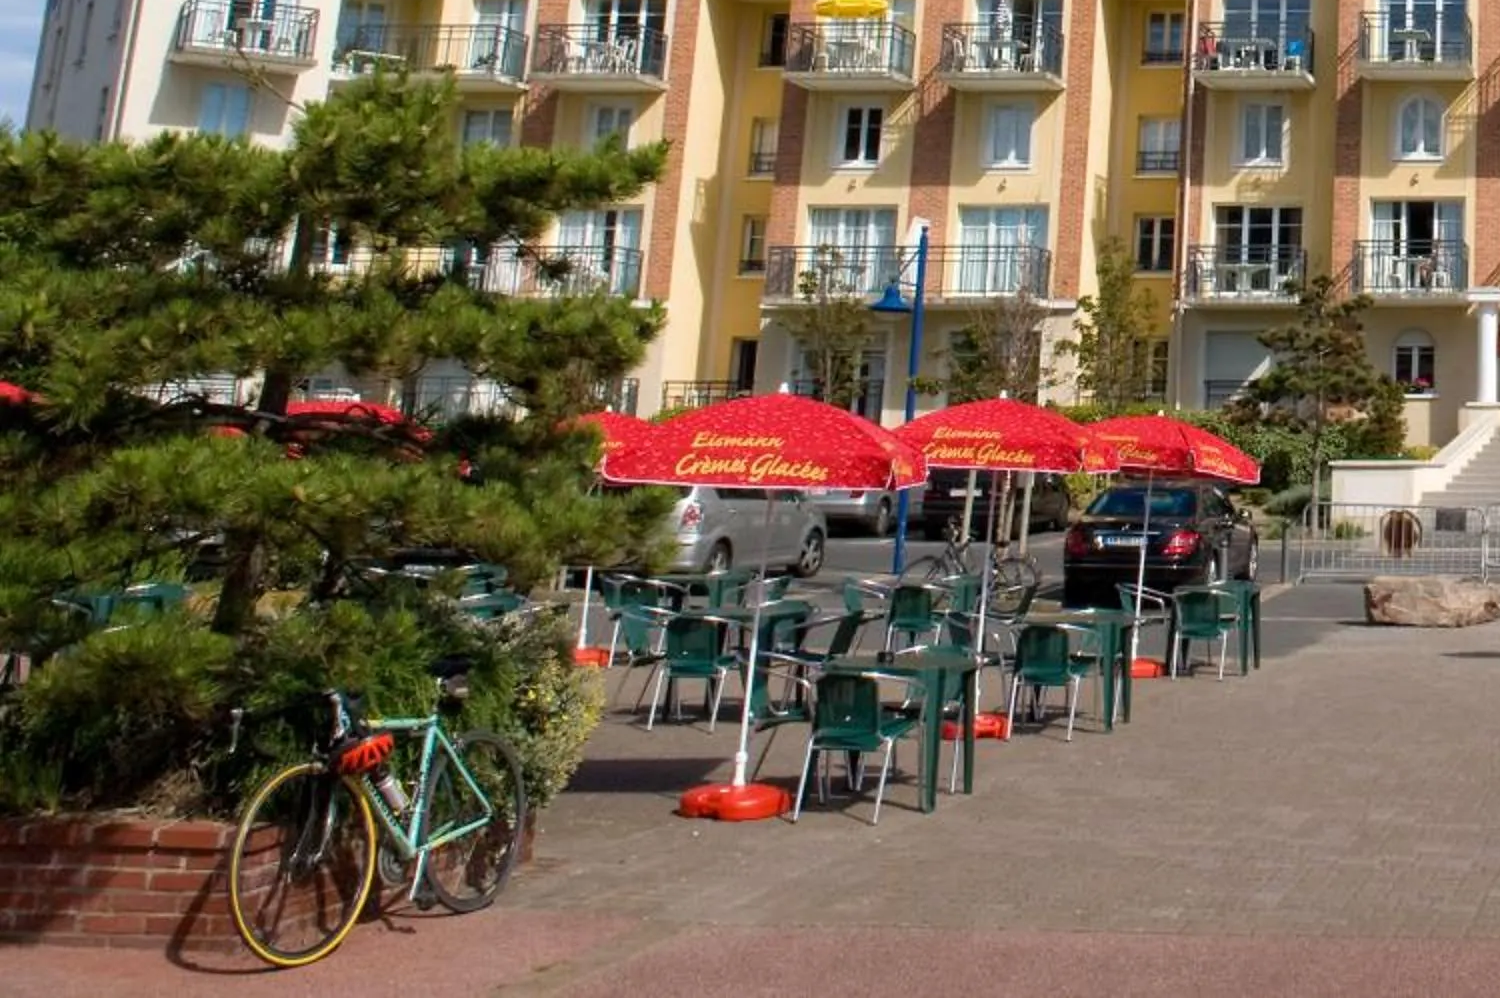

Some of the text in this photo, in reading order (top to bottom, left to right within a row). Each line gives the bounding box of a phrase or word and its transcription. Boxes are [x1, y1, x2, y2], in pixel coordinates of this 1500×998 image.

[692, 430, 785, 448] Eismann
[675, 452, 829, 483] Crèmes Glacées
